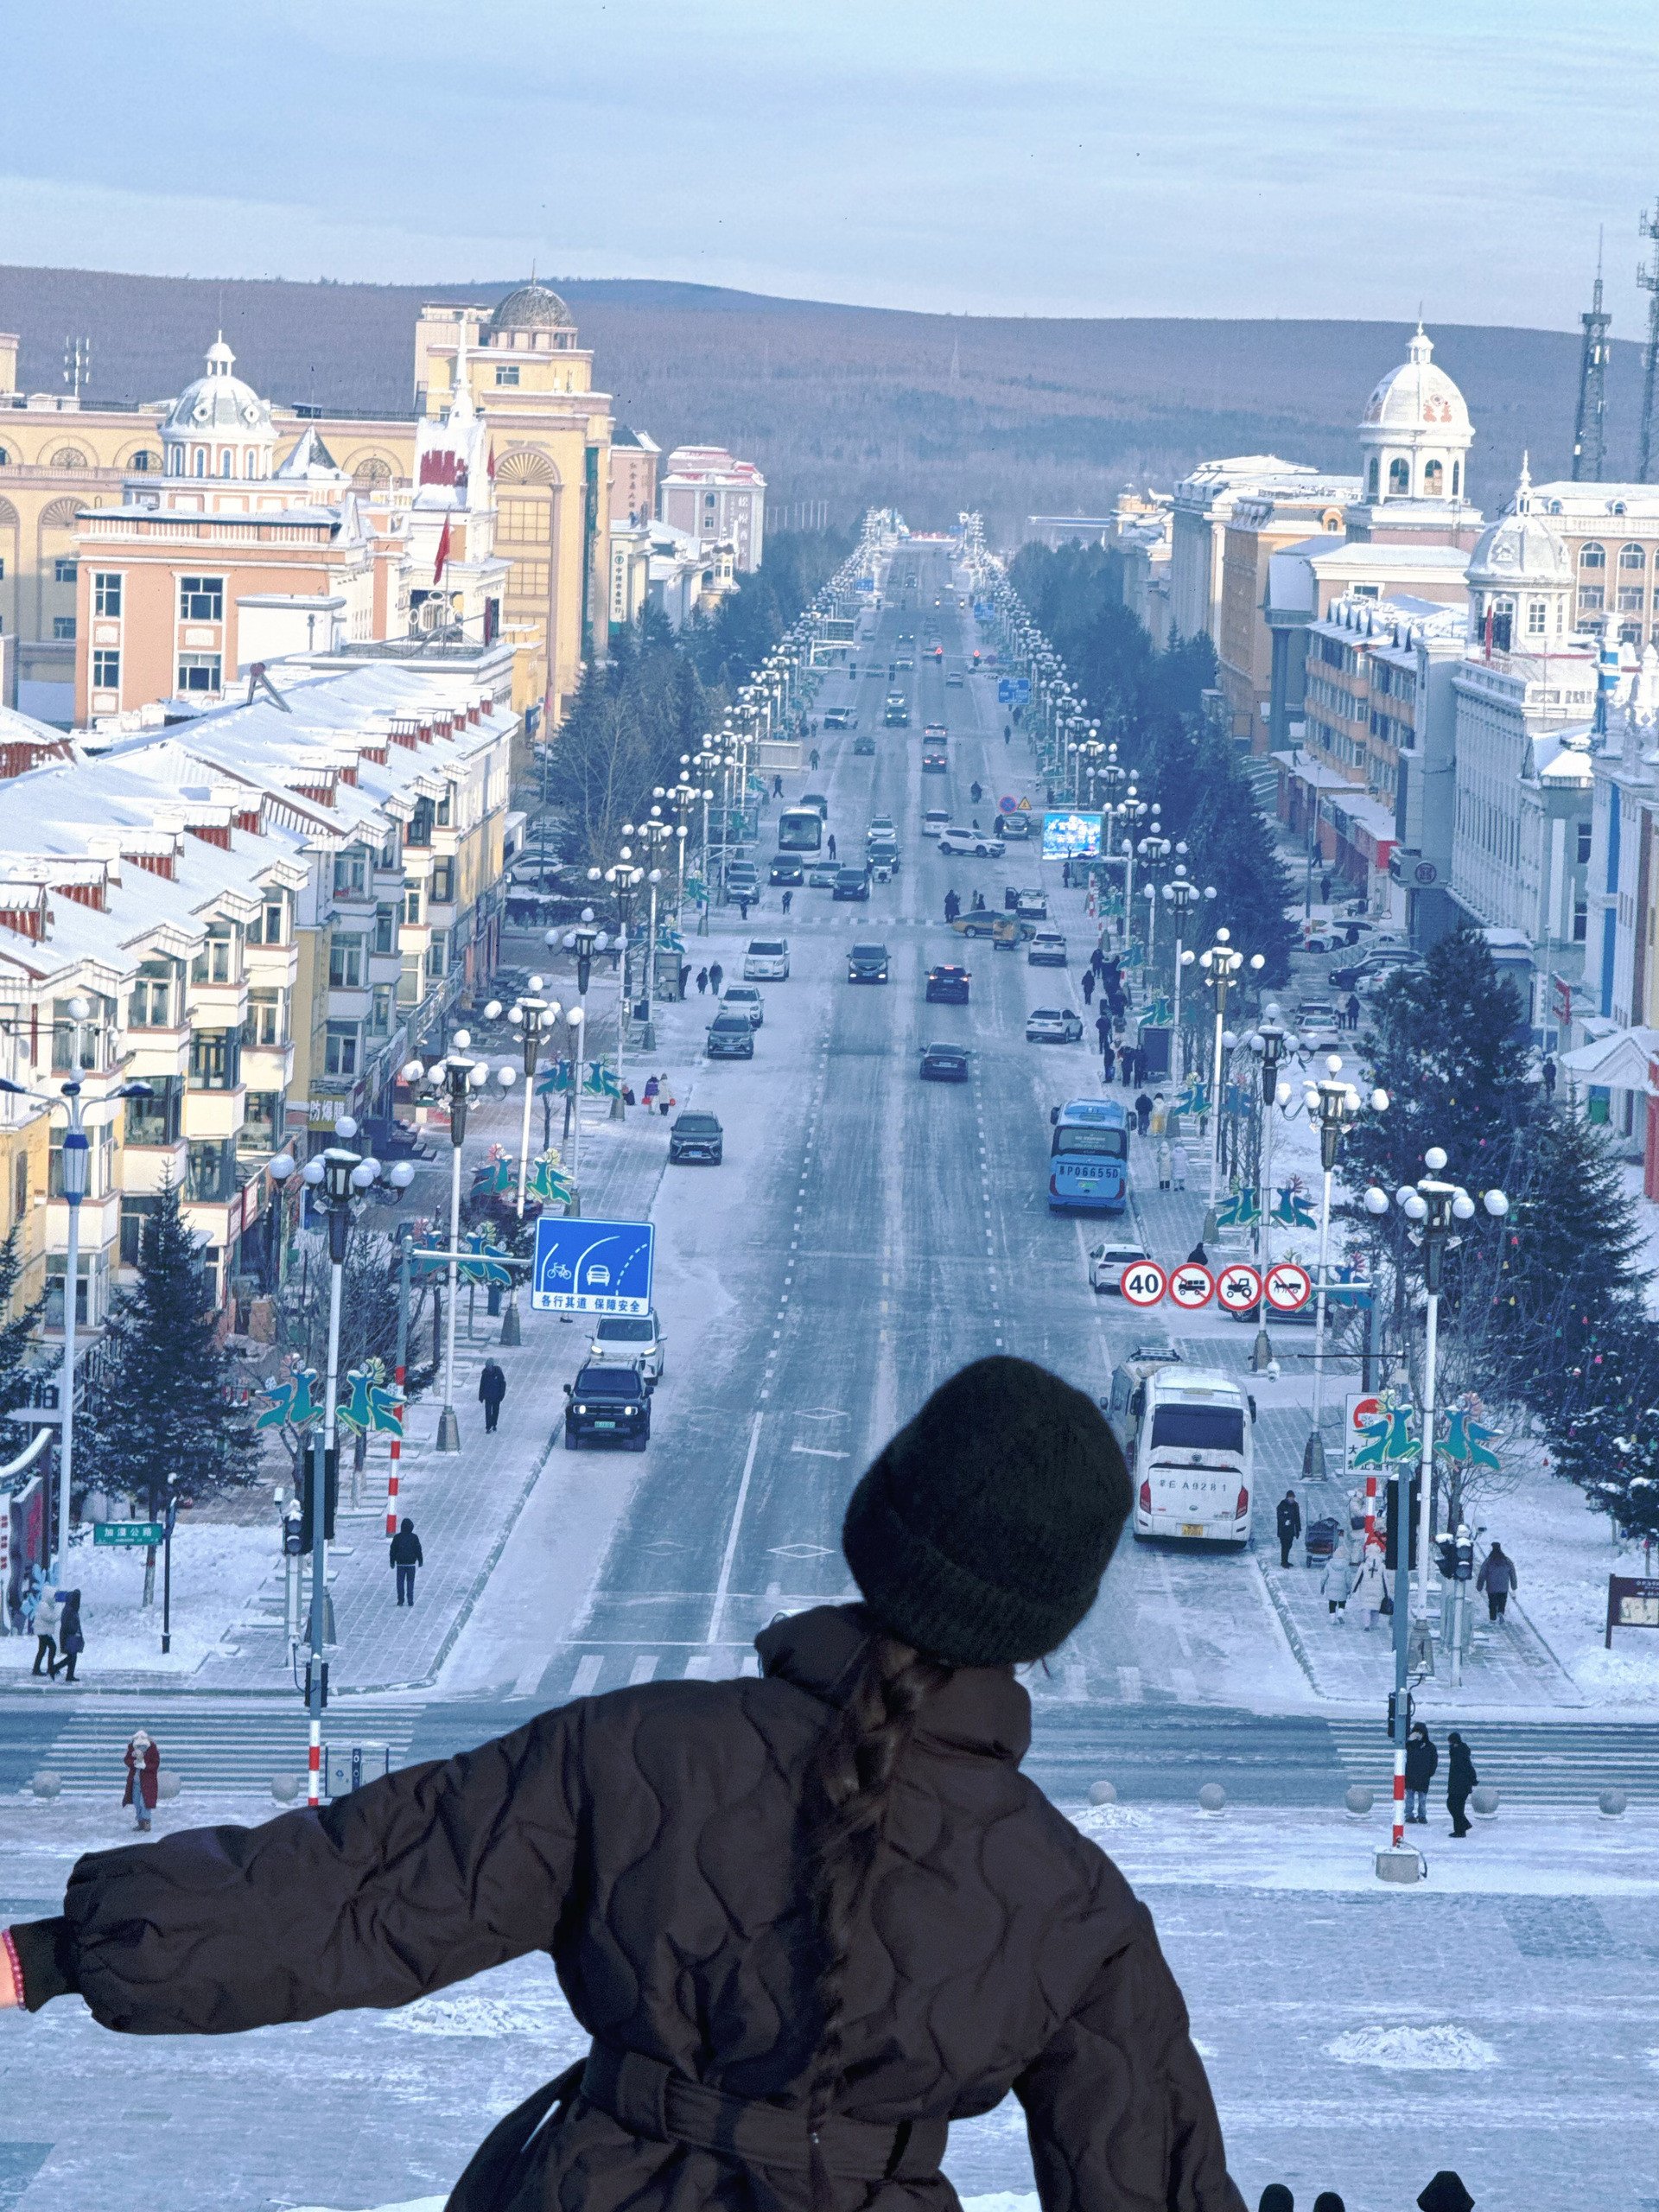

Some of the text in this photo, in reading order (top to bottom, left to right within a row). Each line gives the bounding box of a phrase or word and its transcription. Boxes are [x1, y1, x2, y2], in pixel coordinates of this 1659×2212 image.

[309, 1100, 345, 1122] 防爆膜
[1129, 1274, 1159, 1294] 40
[542, 1294, 639, 1312] 各行其道 保障安全
